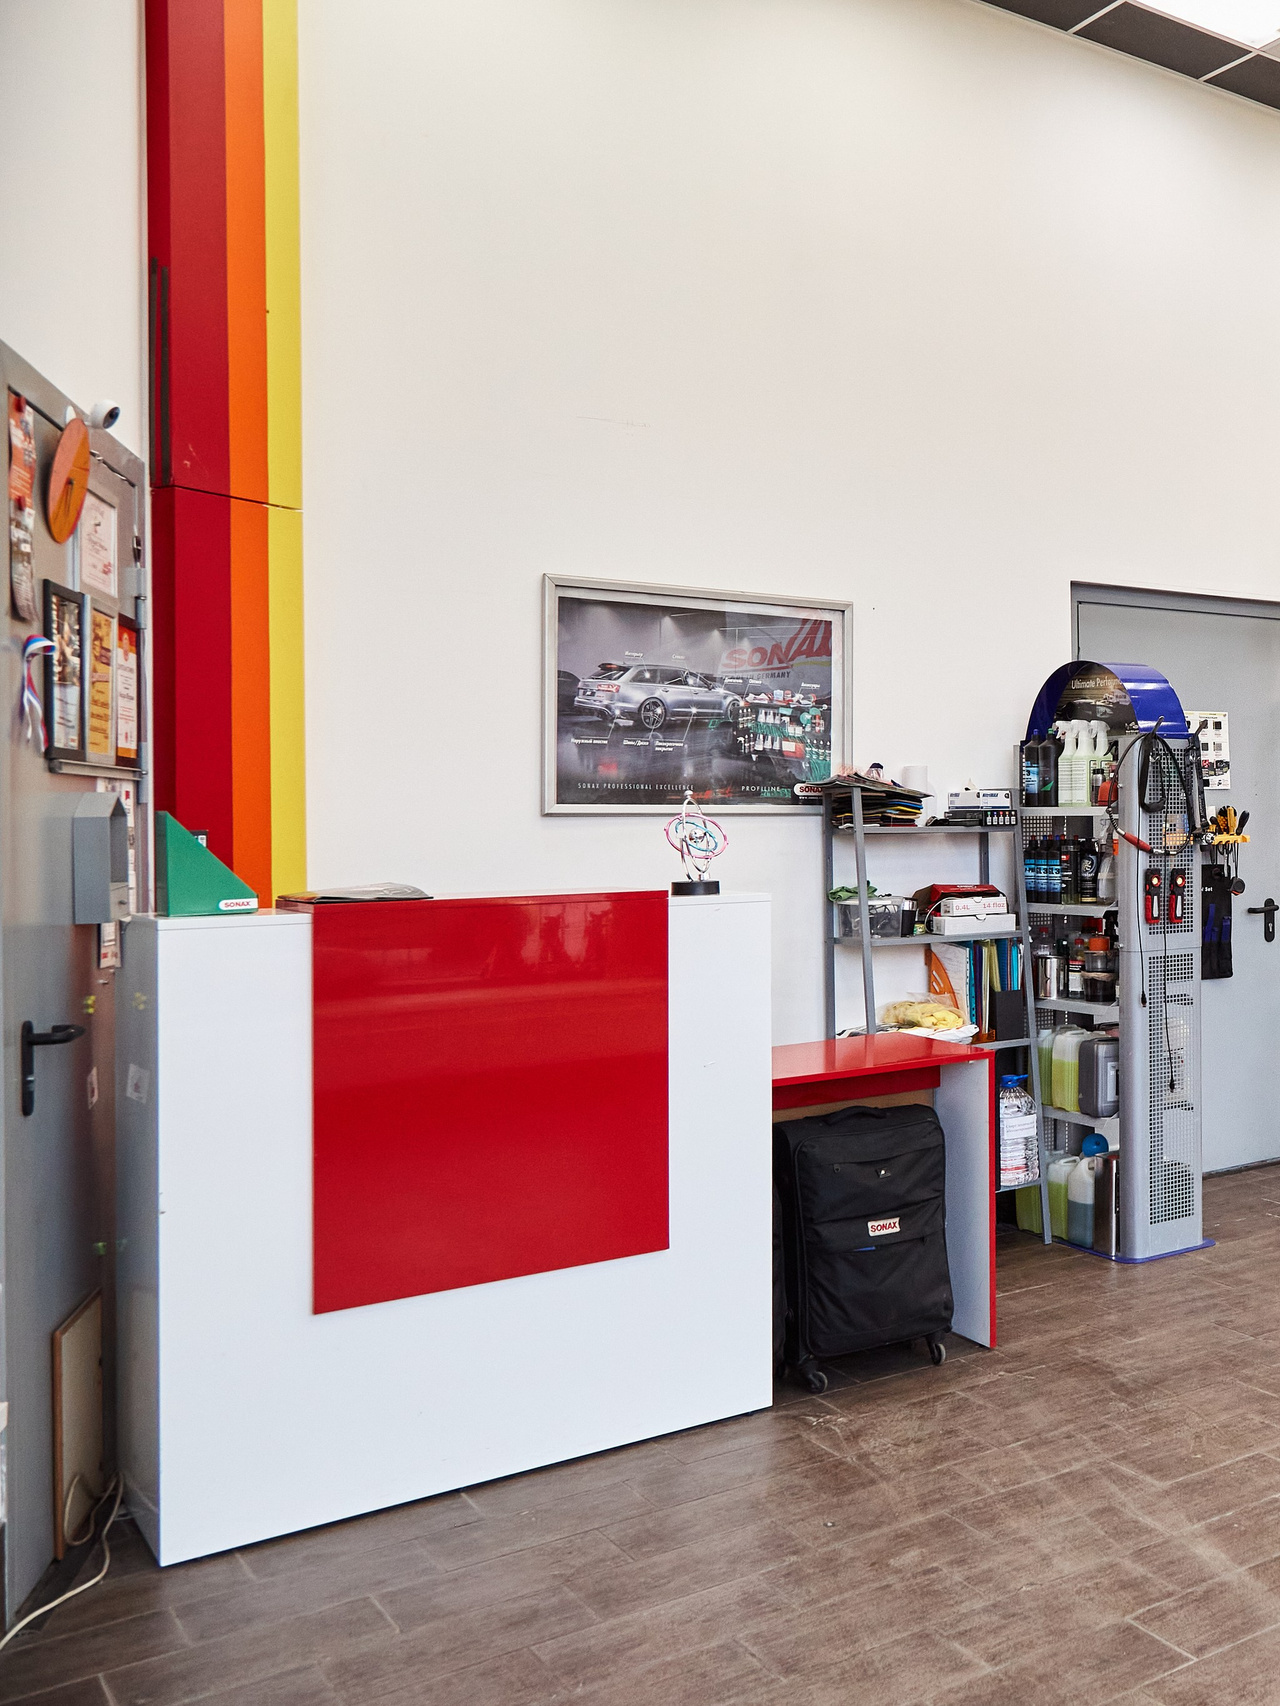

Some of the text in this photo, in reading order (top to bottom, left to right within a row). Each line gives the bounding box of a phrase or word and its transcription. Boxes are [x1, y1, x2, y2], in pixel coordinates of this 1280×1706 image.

[757, 671, 791, 680] GERMANY
[1071, 679, 1096, 690] Ultimate
[870, 1221, 898, 1233] SONAX
